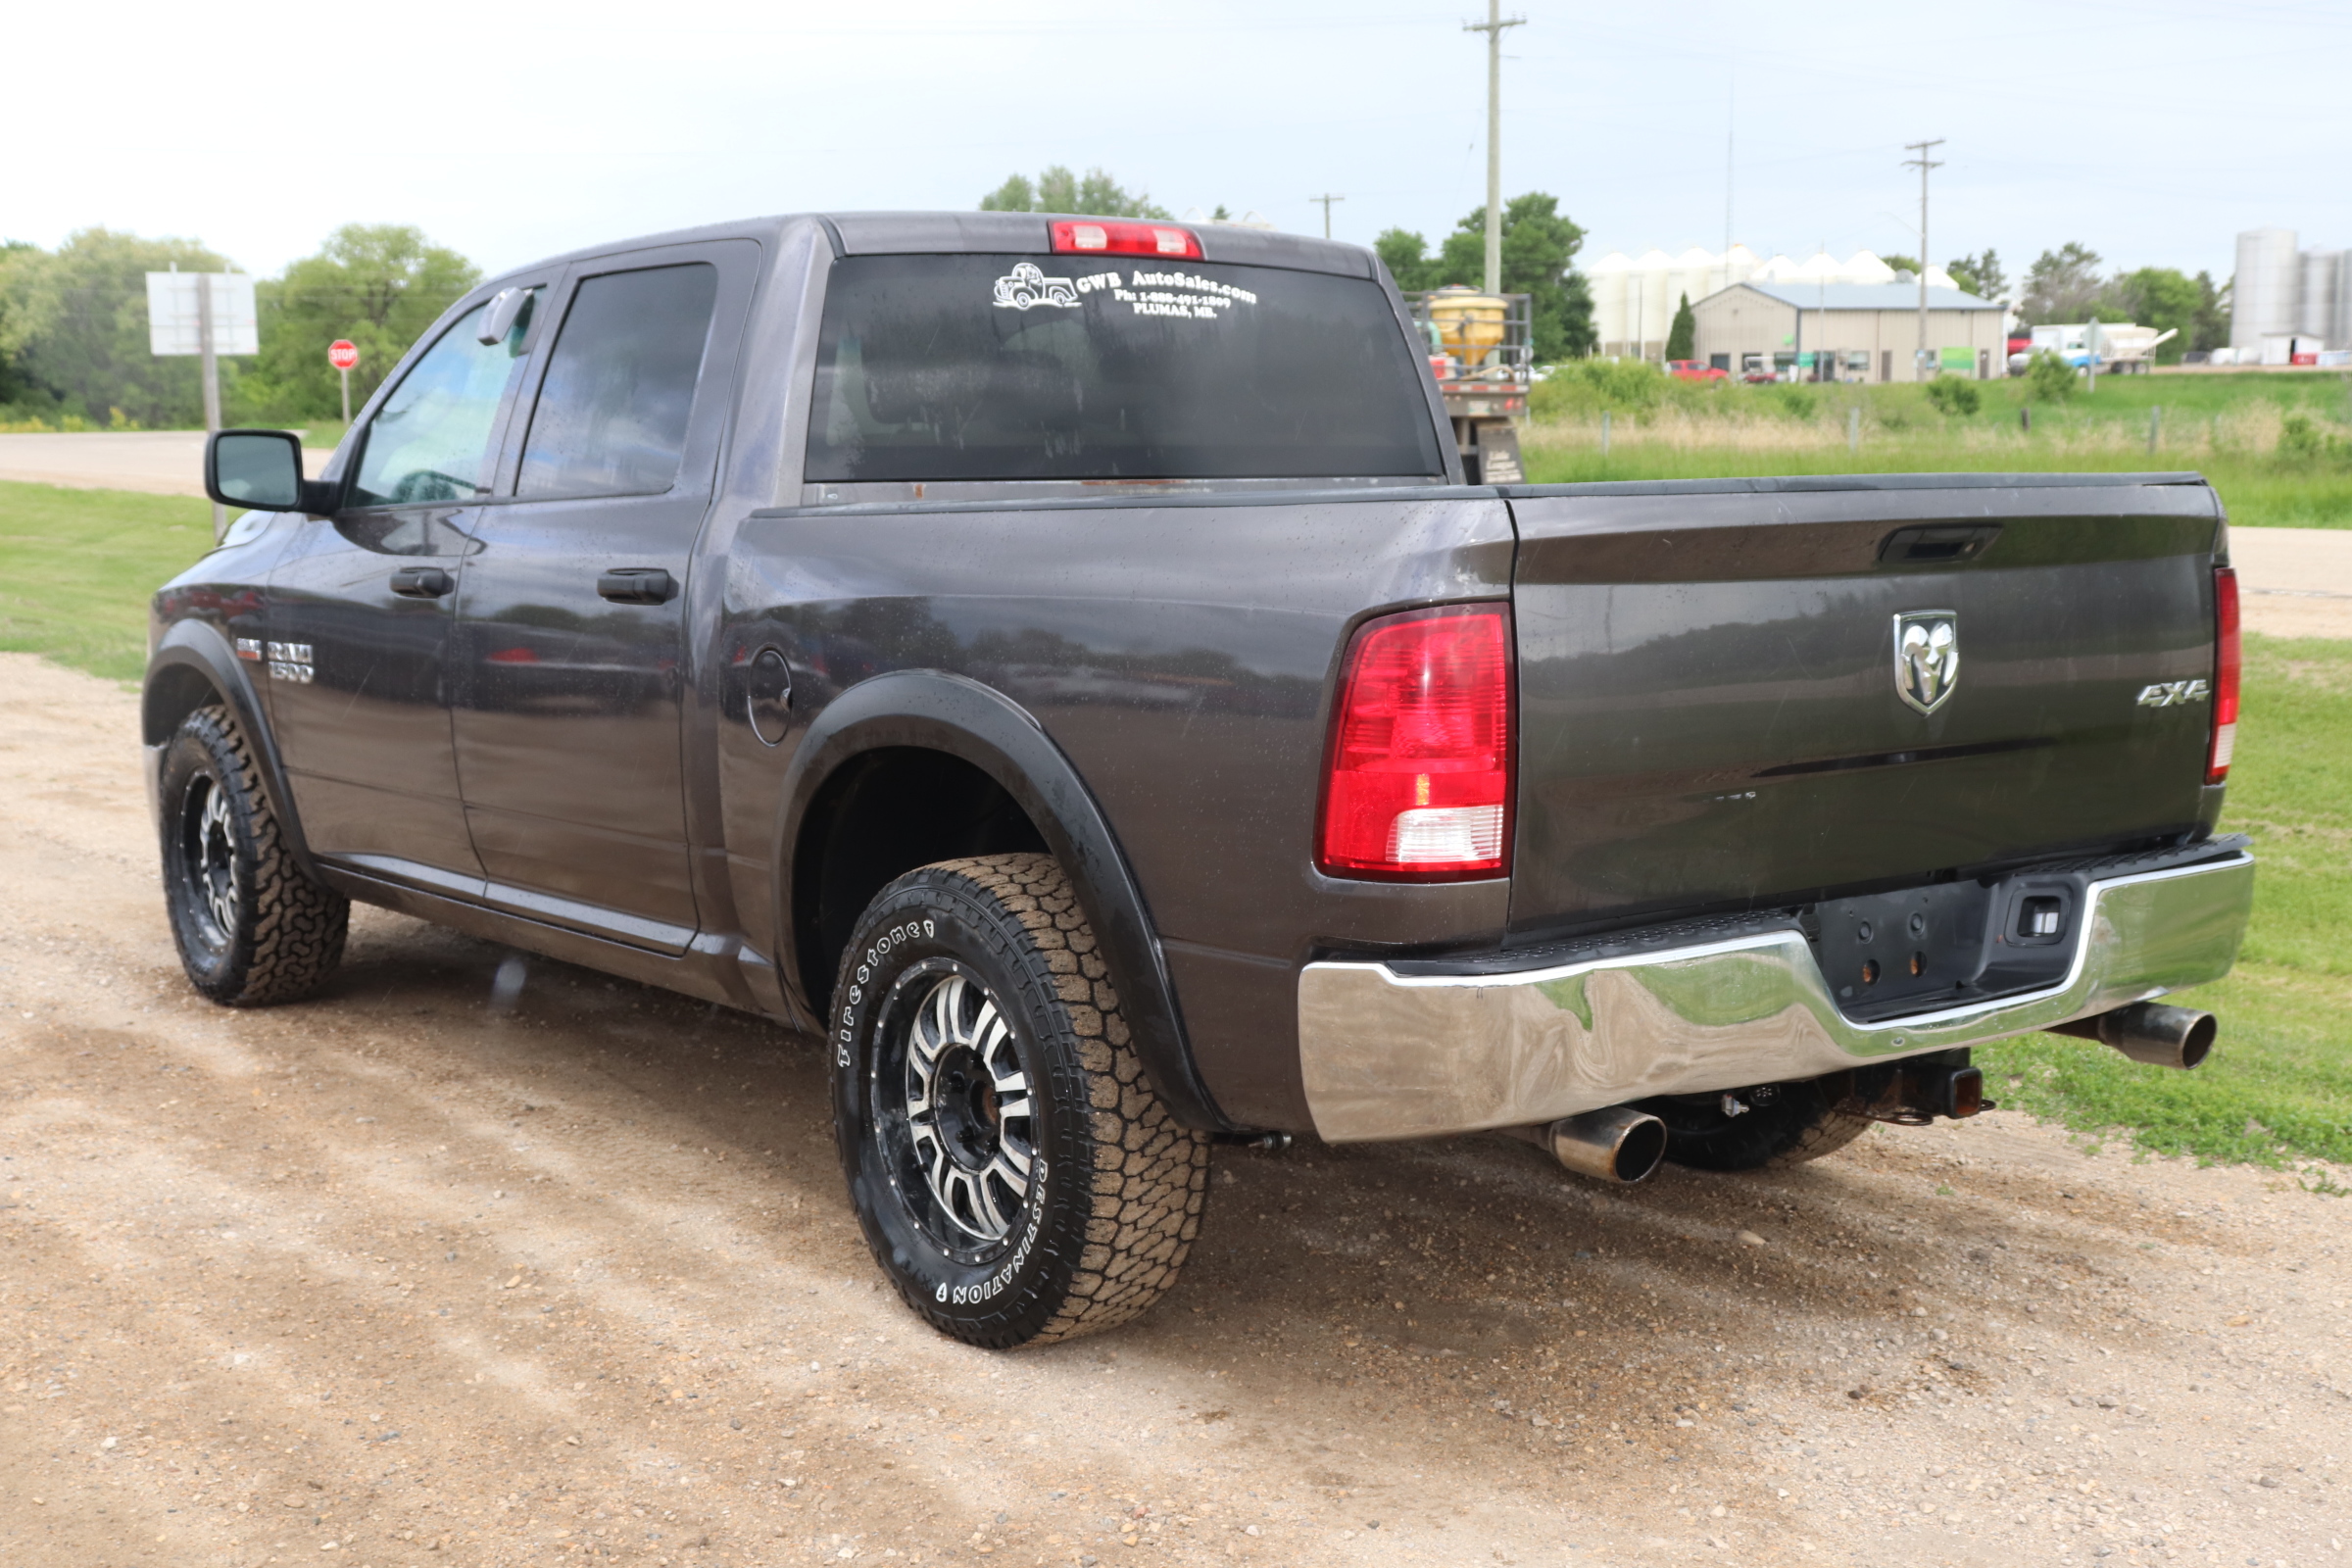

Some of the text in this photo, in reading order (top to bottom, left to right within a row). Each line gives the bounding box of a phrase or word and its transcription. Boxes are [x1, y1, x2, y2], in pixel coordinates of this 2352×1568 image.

[1076, 270, 1257, 304] GWB AutoSales.com
[1113, 288, 1138, 302] Ph:
[1133, 303, 1193, 319] PLUMAS,
[330, 348, 356, 362] STOP
[269, 661, 315, 684] 1500
[953, 1158, 1049, 1304] DESTINATION
